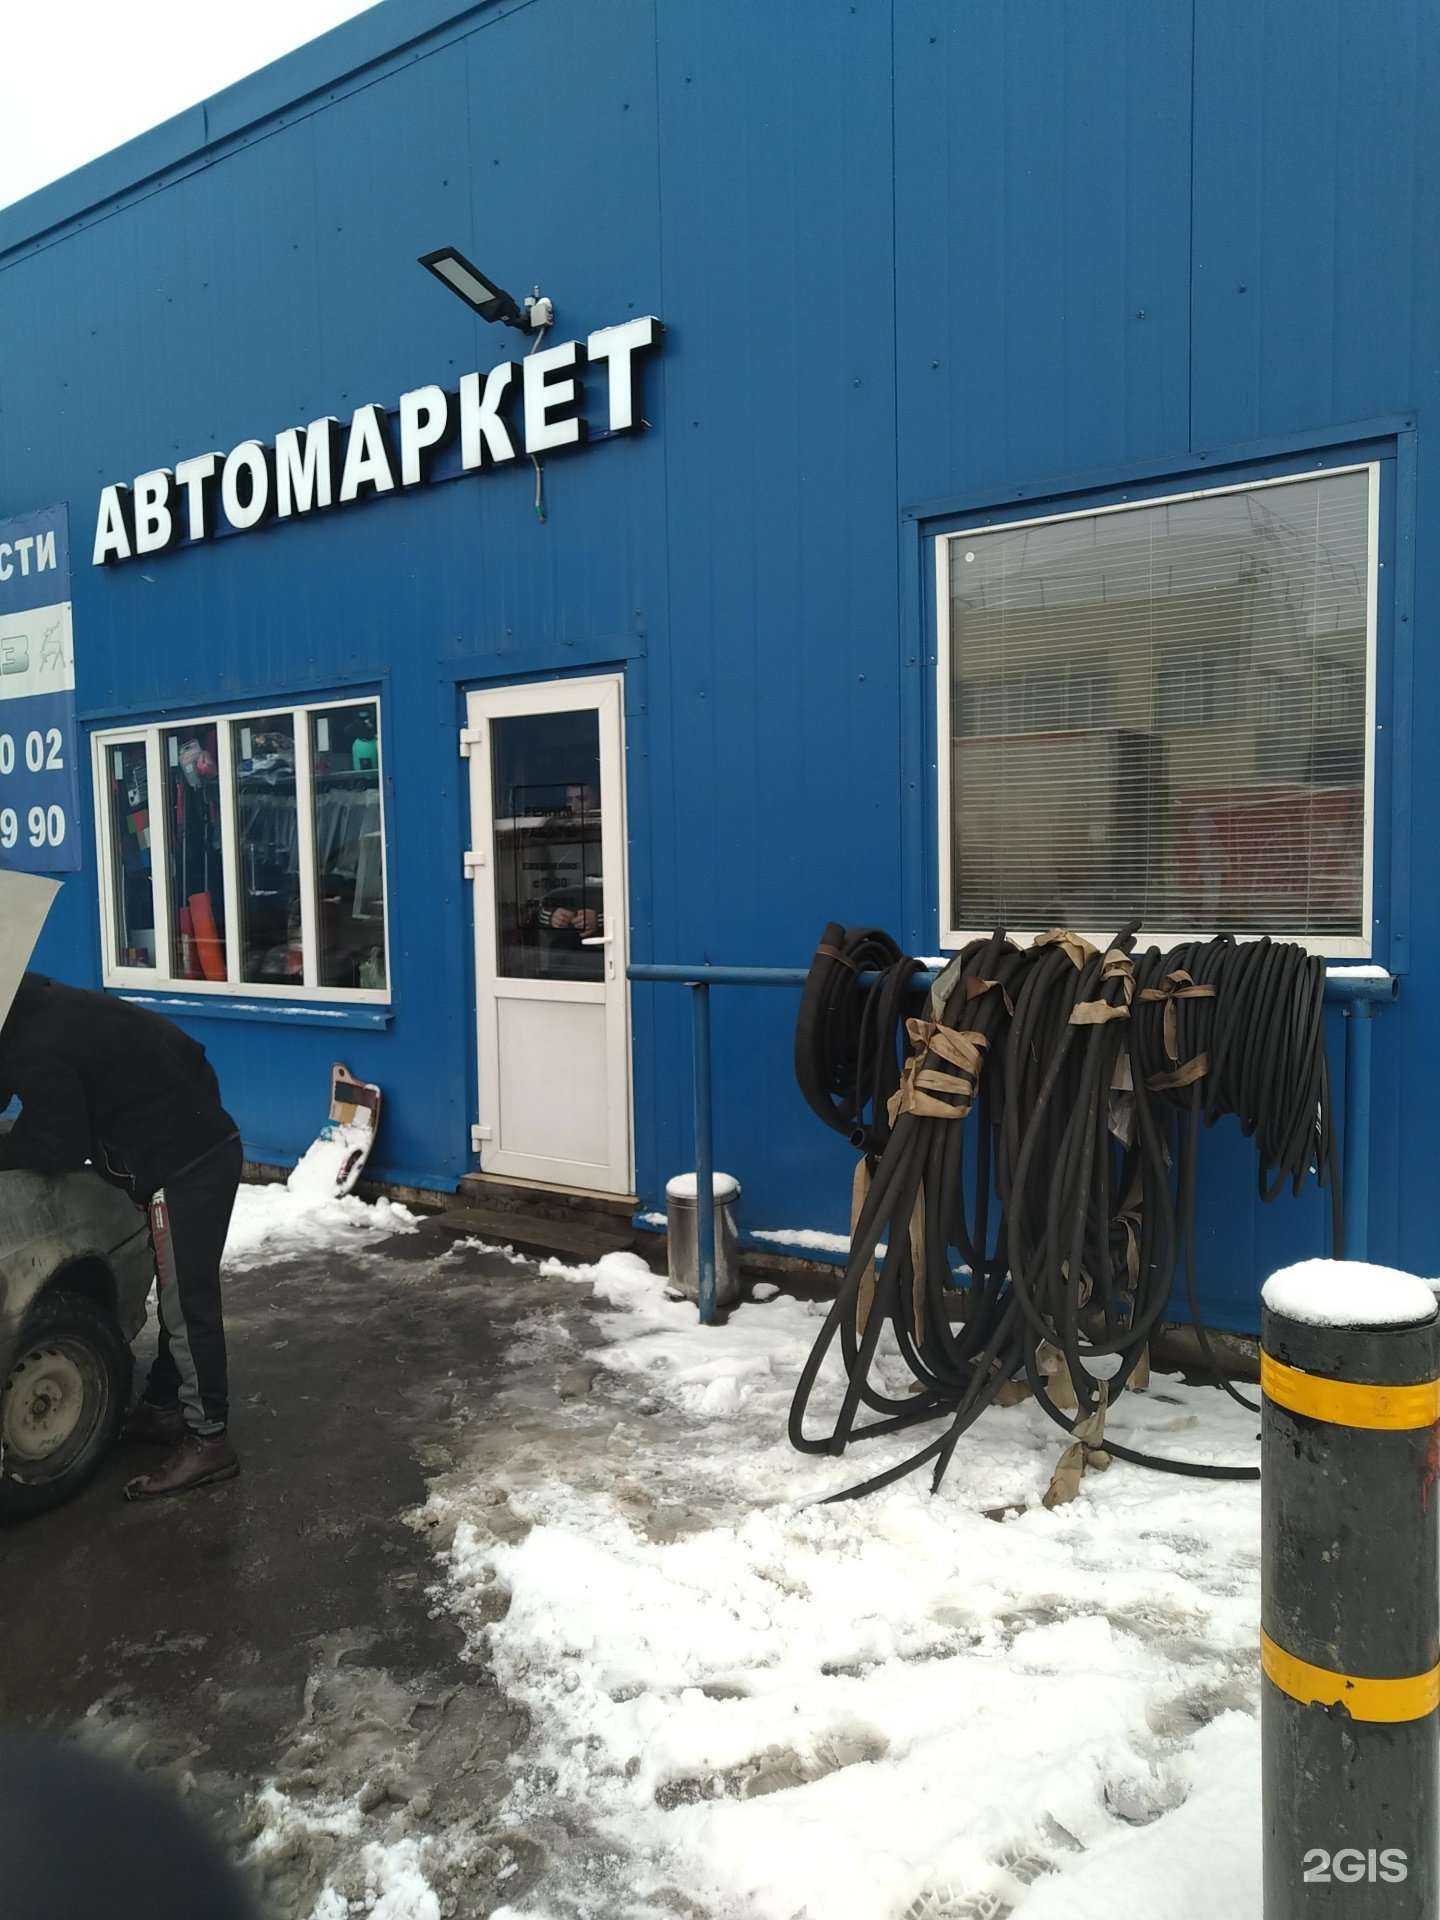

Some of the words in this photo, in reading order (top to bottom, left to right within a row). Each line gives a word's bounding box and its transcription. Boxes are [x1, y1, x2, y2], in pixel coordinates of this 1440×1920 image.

[92, 317, 656, 565] АВТОМАРКЕТ
[25, 728, 64, 772] 02
[0, 808, 18, 848] 9
[28, 805, 66, 847] 90
